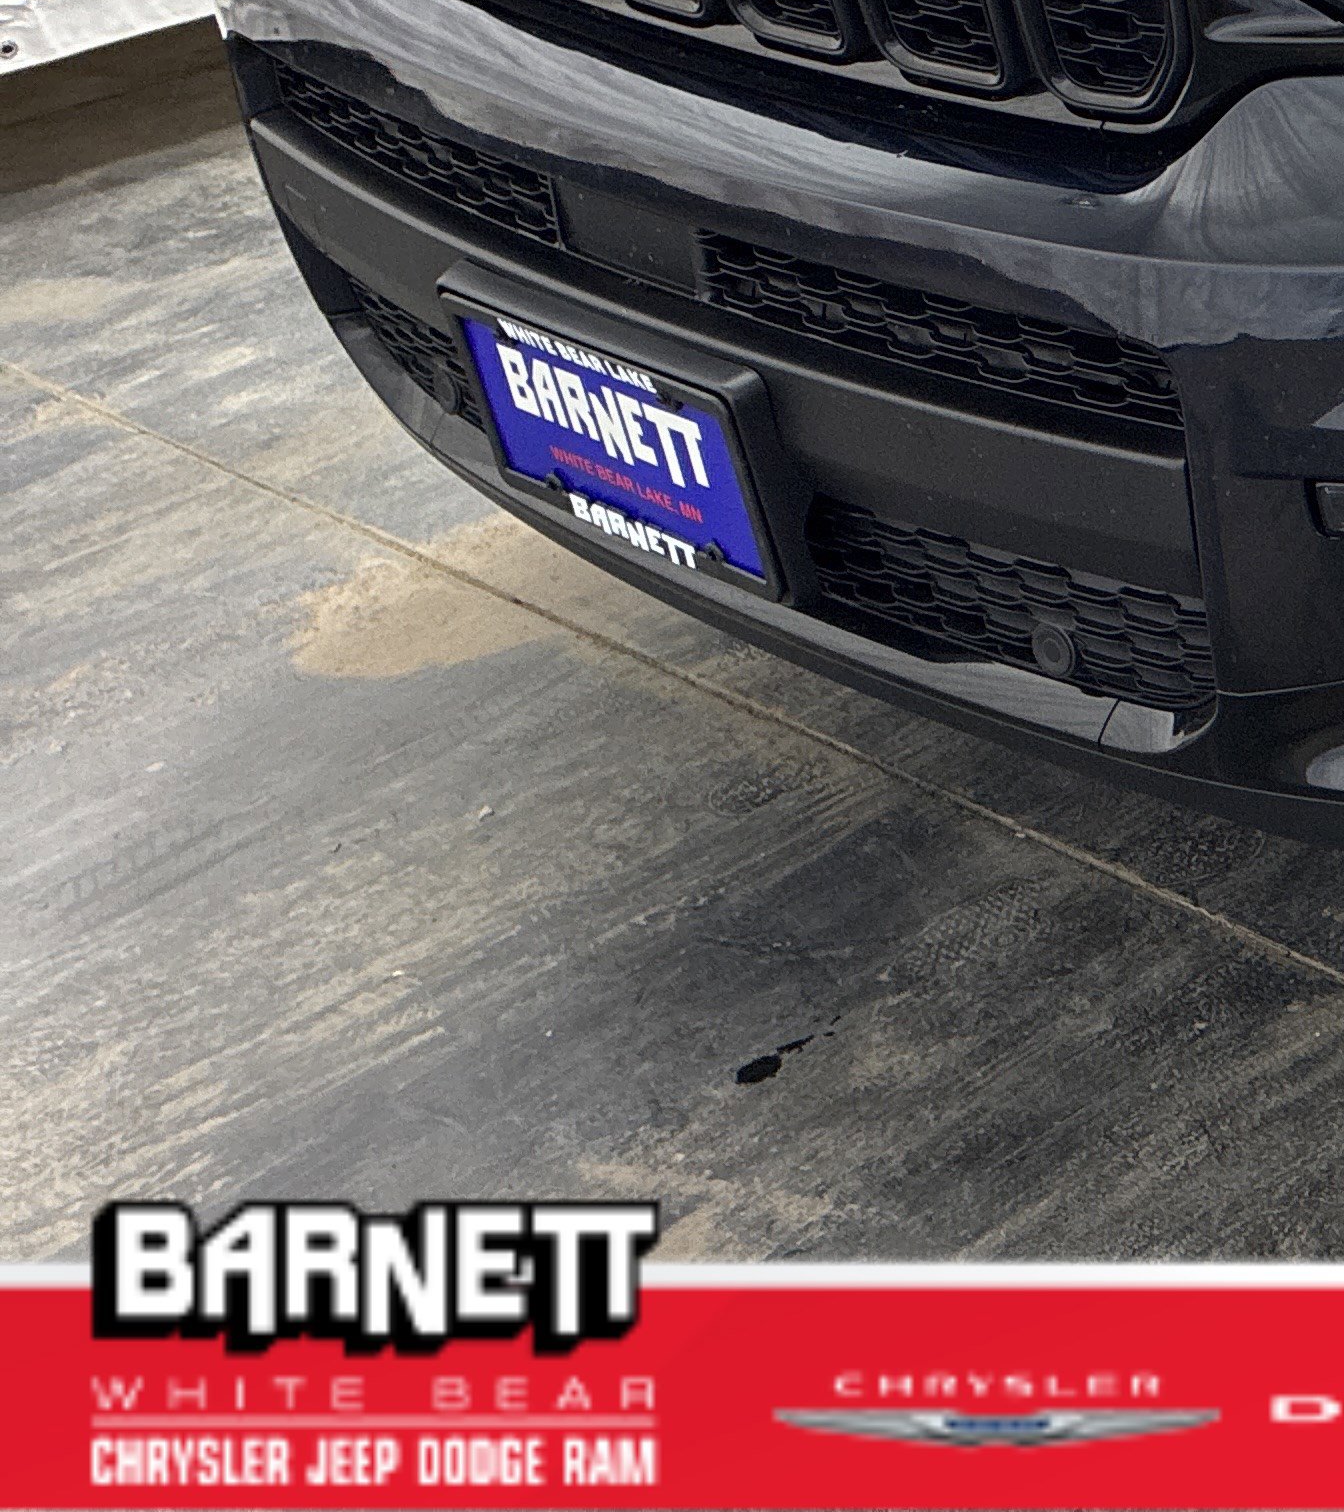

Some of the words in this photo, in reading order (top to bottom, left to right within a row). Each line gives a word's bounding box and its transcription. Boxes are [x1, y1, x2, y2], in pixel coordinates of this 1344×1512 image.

[497, 318, 558, 356] WHITE
[554, 340, 607, 375] BEAR
[604, 359, 657, 394] LAKE
[495, 342, 710, 488] BARNETT
[550, 445, 595, 476] WHITE
[594, 464, 636, 493] BEAR
[569, 494, 697, 569] BARNETT
